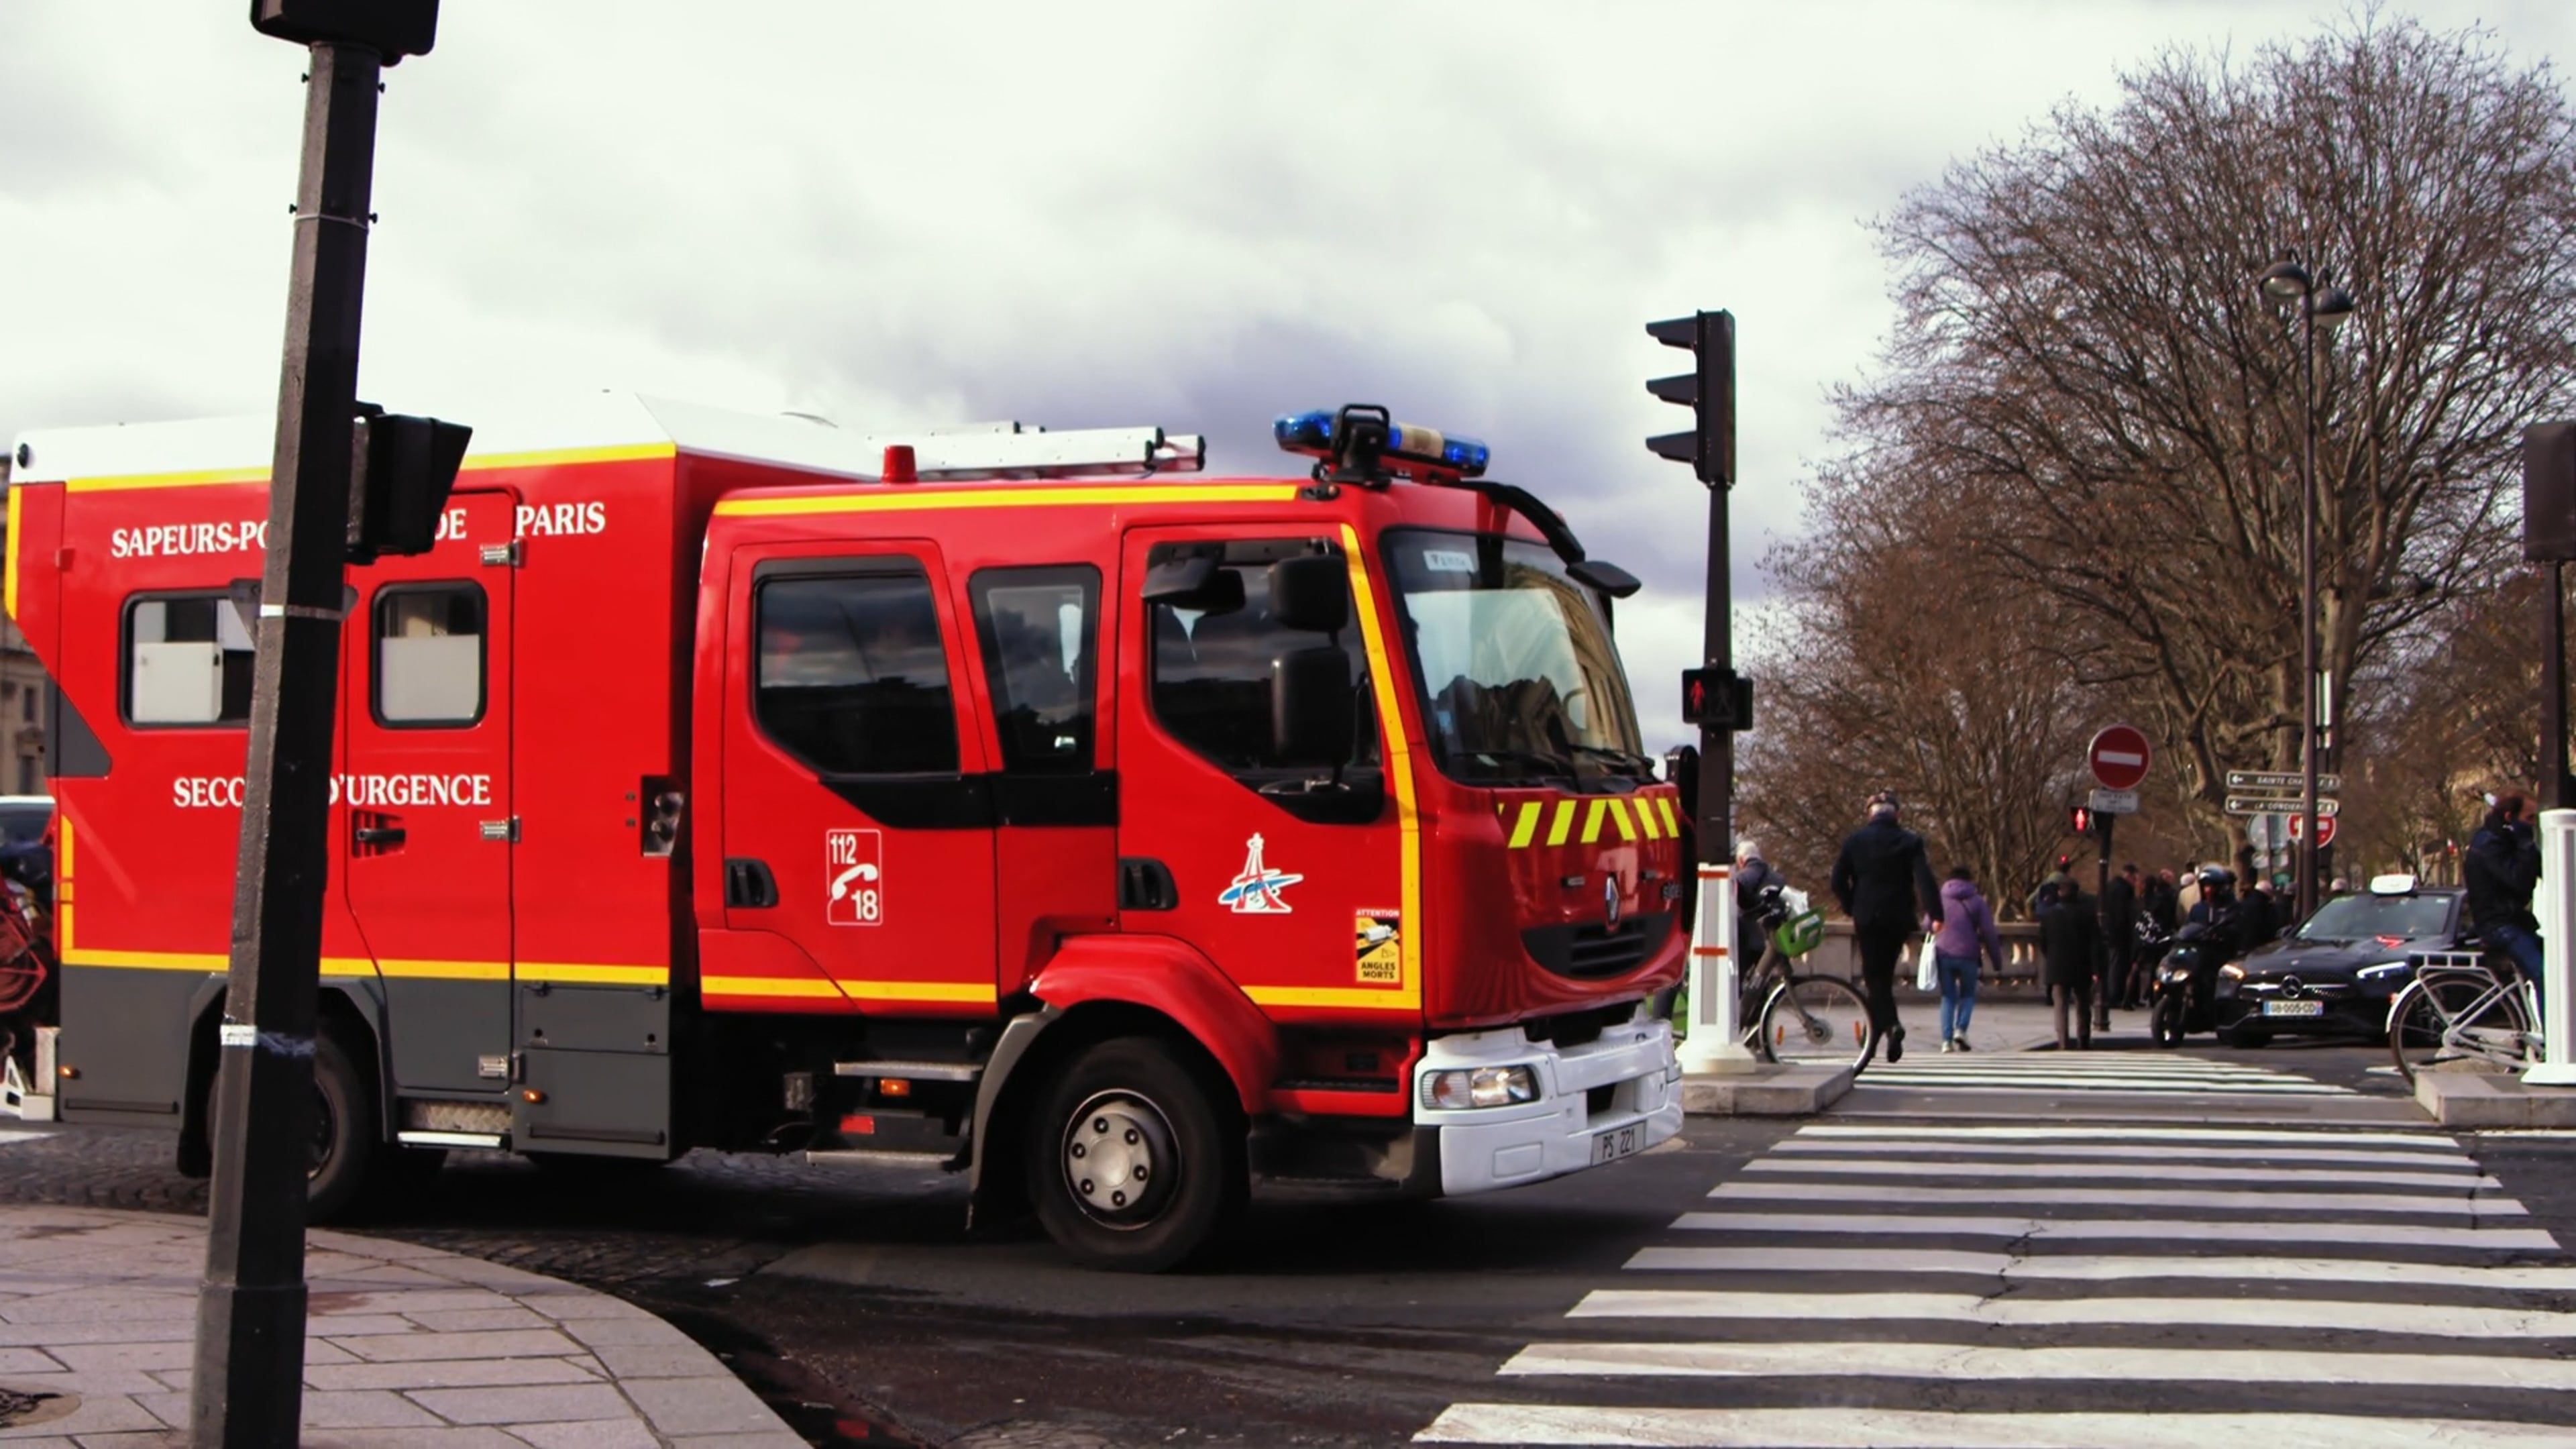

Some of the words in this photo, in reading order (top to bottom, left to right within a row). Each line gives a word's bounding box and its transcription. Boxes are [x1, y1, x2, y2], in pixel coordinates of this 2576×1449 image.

[111, 520, 269, 558] SAPEURS-PO
[515, 502, 606, 537] PARIS
[173, 777, 246, 807] SECO
[830, 834, 857, 864] 112
[851, 889, 878, 920] 18
[1356, 908, 1399, 917] ATTENTION
[1361, 962, 1396, 971] ANGLES
[1602, 1134, 1613, 1159] PS
[1620, 1128, 1635, 1154] 221
